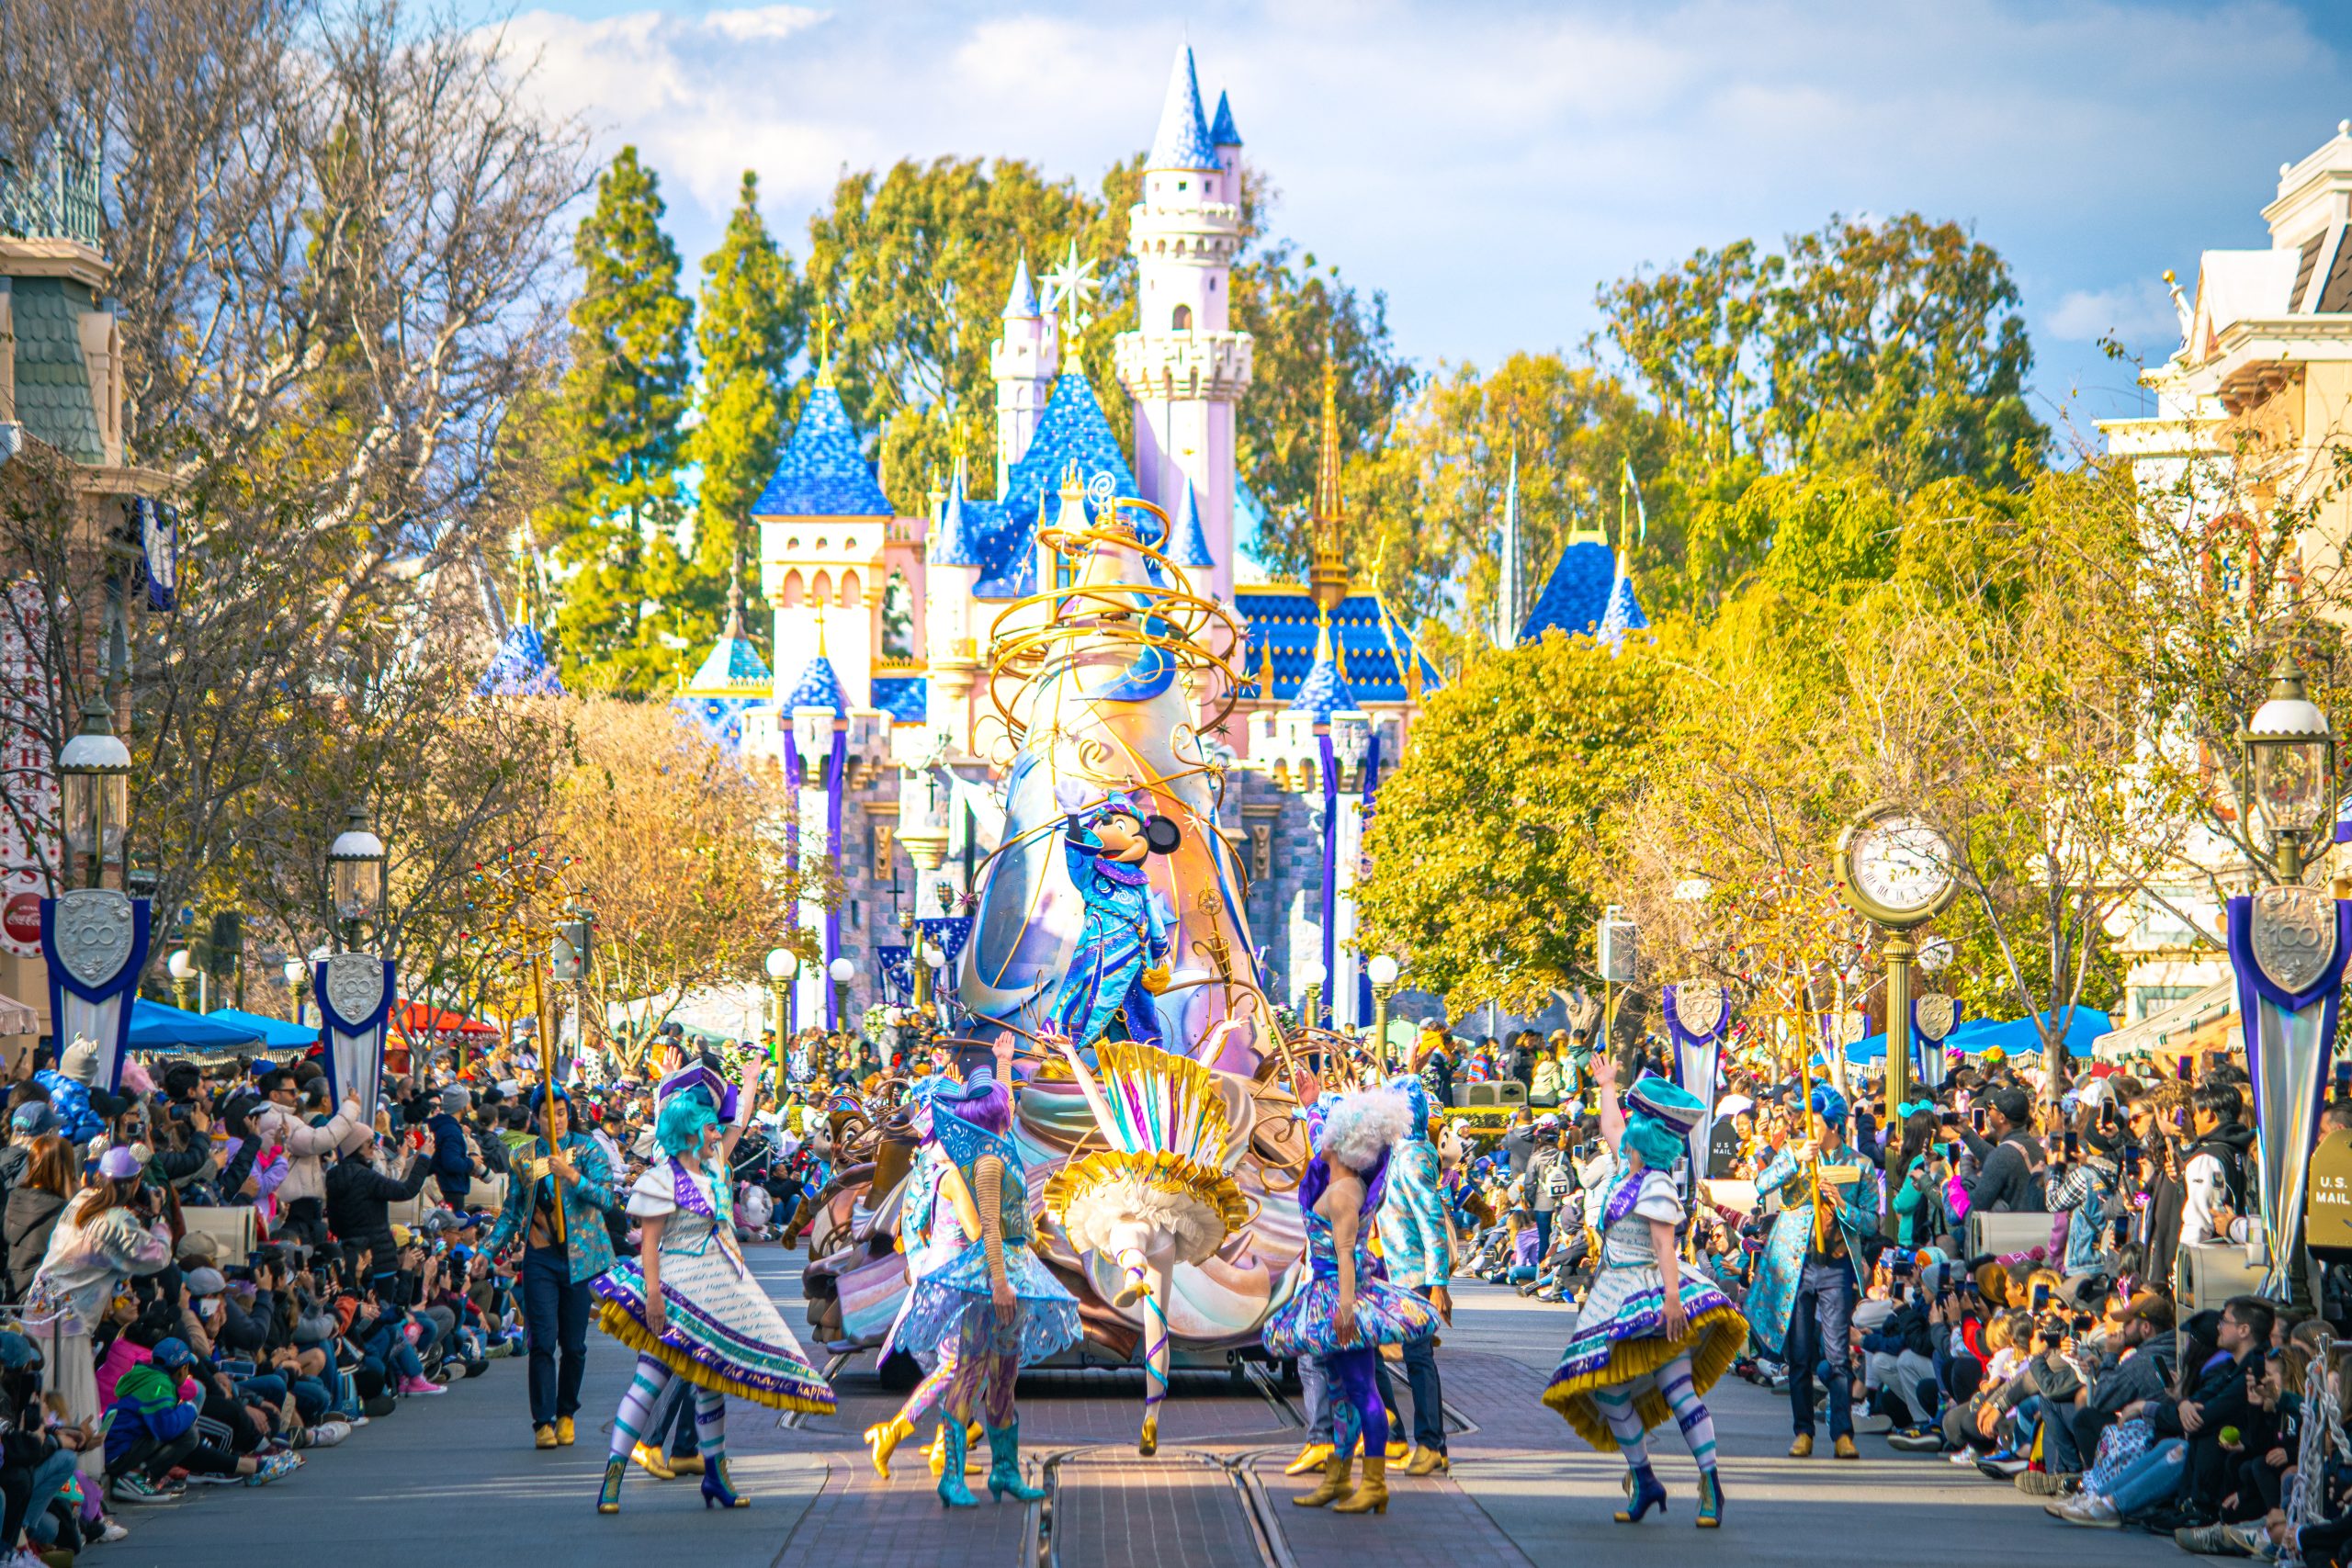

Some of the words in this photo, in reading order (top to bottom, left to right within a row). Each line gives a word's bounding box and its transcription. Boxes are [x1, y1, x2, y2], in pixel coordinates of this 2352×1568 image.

[2269, 925, 2319, 948] 100
[337, 979, 371, 995] 100
[2320, 1176, 2348, 1189] U.S.
[2315, 1190, 2351, 1205] MAIL
[722, 1364, 745, 1380] the
[746, 1374, 793, 1392] magic
